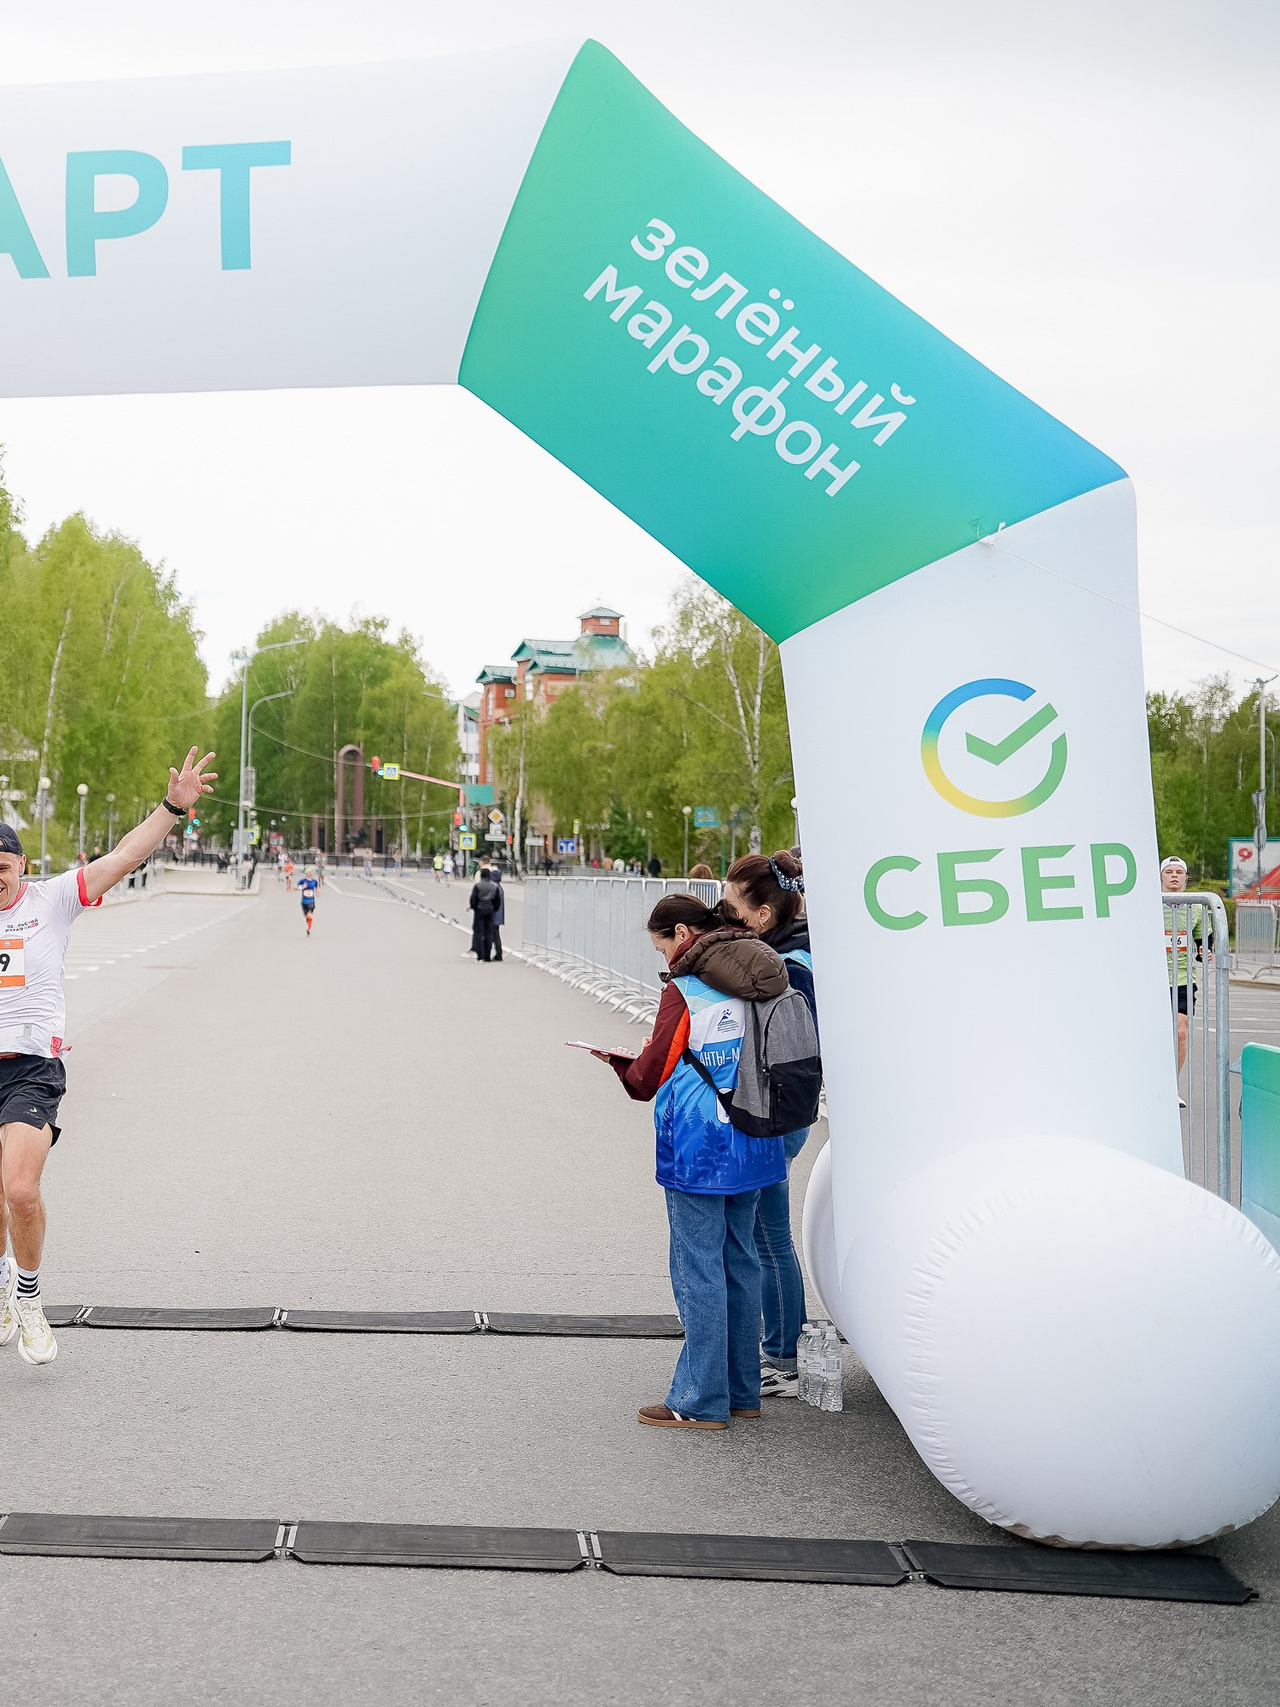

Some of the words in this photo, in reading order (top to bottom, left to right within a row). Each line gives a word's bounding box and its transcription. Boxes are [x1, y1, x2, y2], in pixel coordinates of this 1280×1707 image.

[583, 264, 862, 498] марафон
[630, 217, 917, 447] зелёный
[863, 842, 1138, 931] СБЕР
